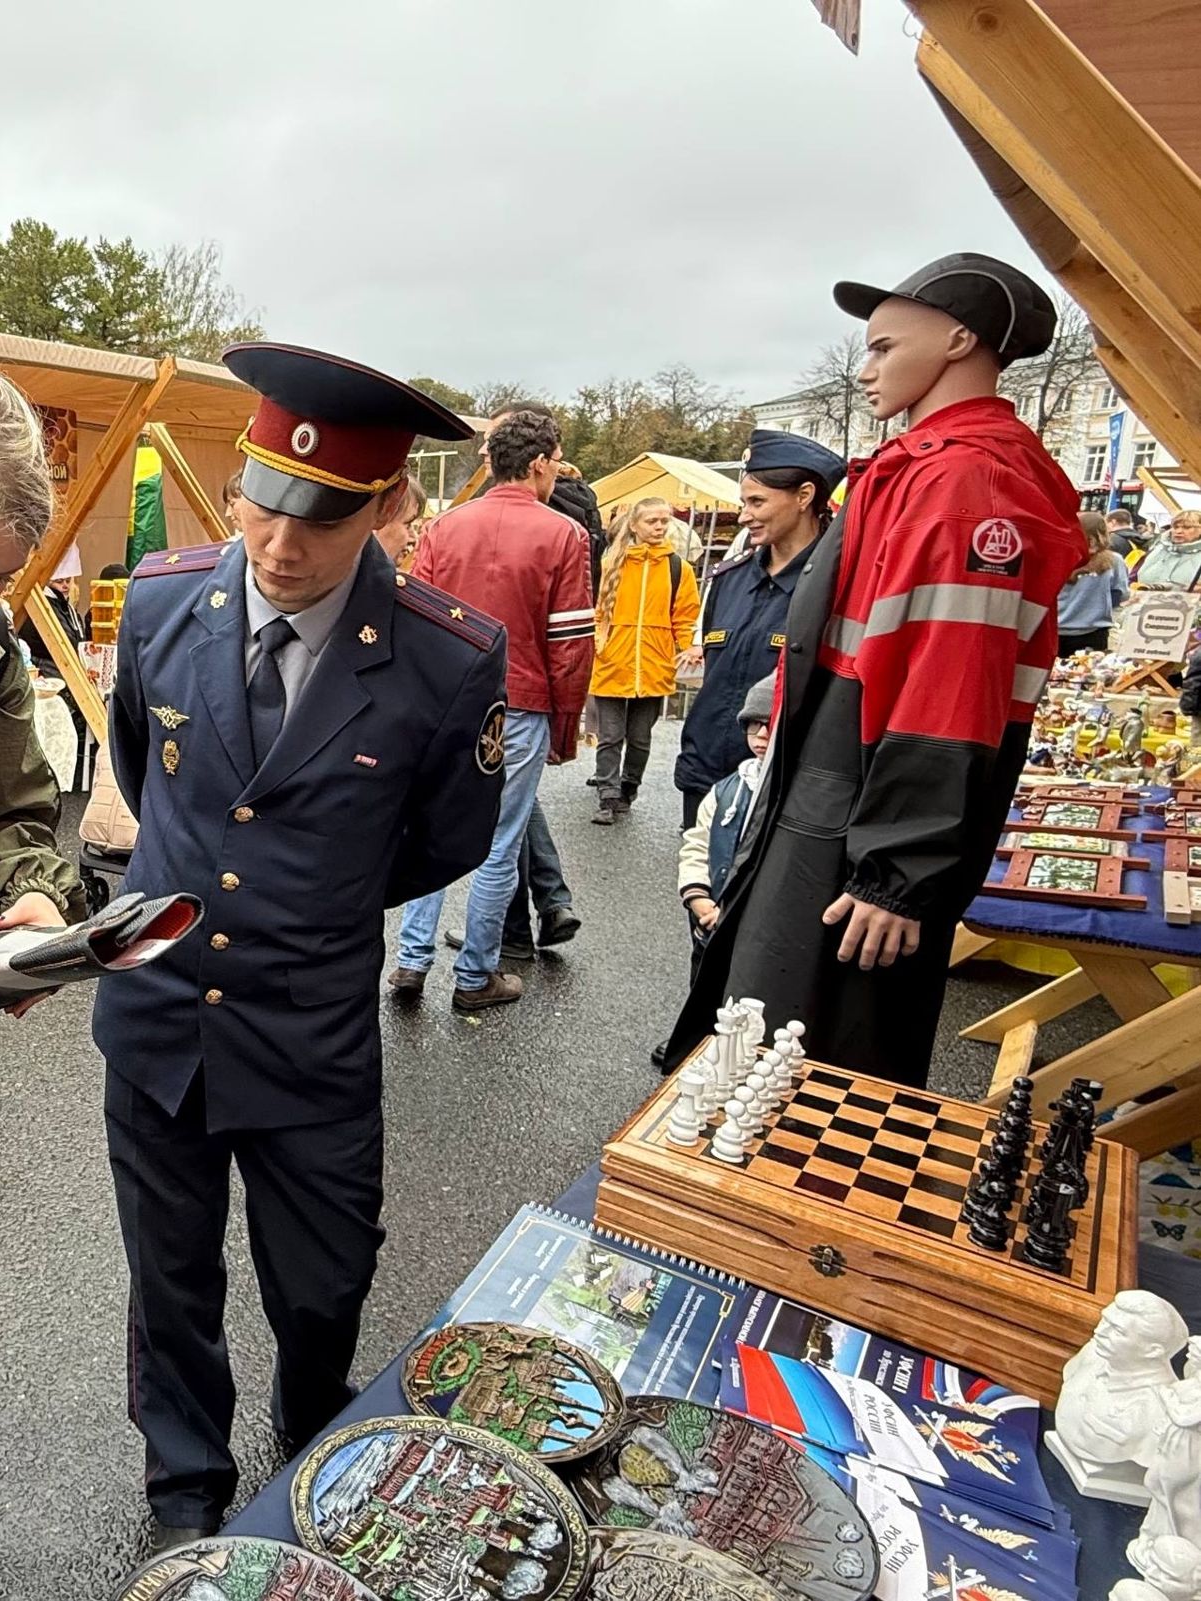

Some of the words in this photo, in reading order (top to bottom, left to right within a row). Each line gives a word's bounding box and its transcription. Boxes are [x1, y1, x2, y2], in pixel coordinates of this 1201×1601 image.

[863, 1393, 883, 1434] РОССИИ
[882, 1401, 900, 1438] УФСИН
[878, 1524, 902, 1555] РОСС
[883, 1538, 920, 1574] УФСИН
